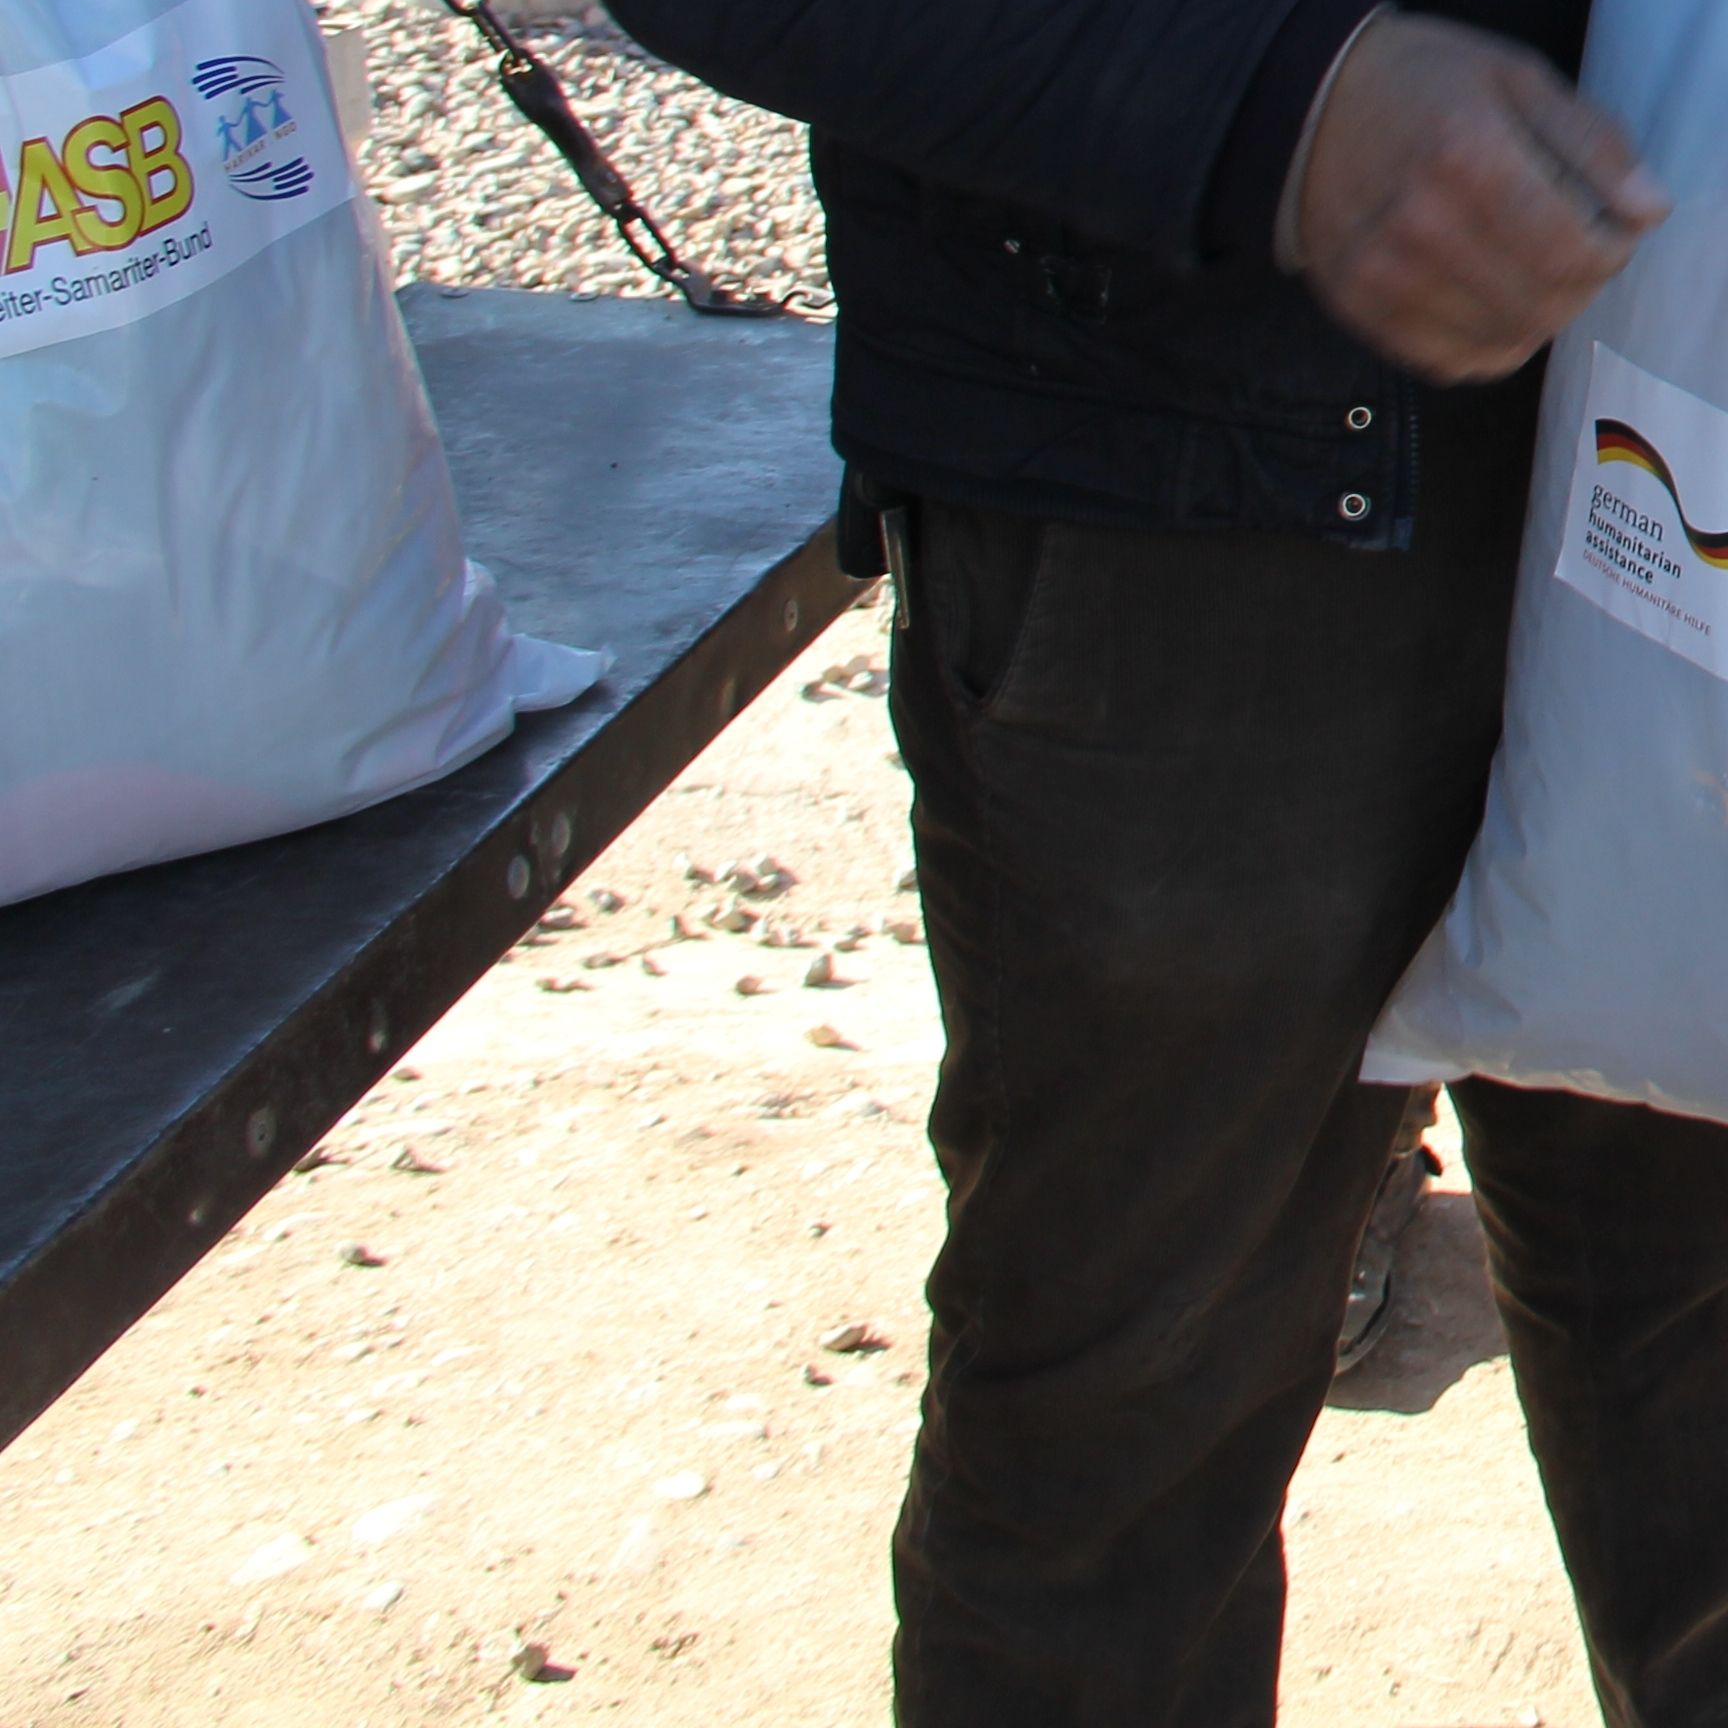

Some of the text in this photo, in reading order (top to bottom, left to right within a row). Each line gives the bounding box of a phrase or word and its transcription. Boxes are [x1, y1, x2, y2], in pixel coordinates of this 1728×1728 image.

[6, 94, 195, 273] ASB
[1588, 507, 1682, 579] humanitarian
[1591, 483, 1664, 542] german
[1582, 548, 1621, 584] DEUTSCHE
[1684, 612, 1712, 636] HILFE
[1585, 530, 1654, 584] assistance
